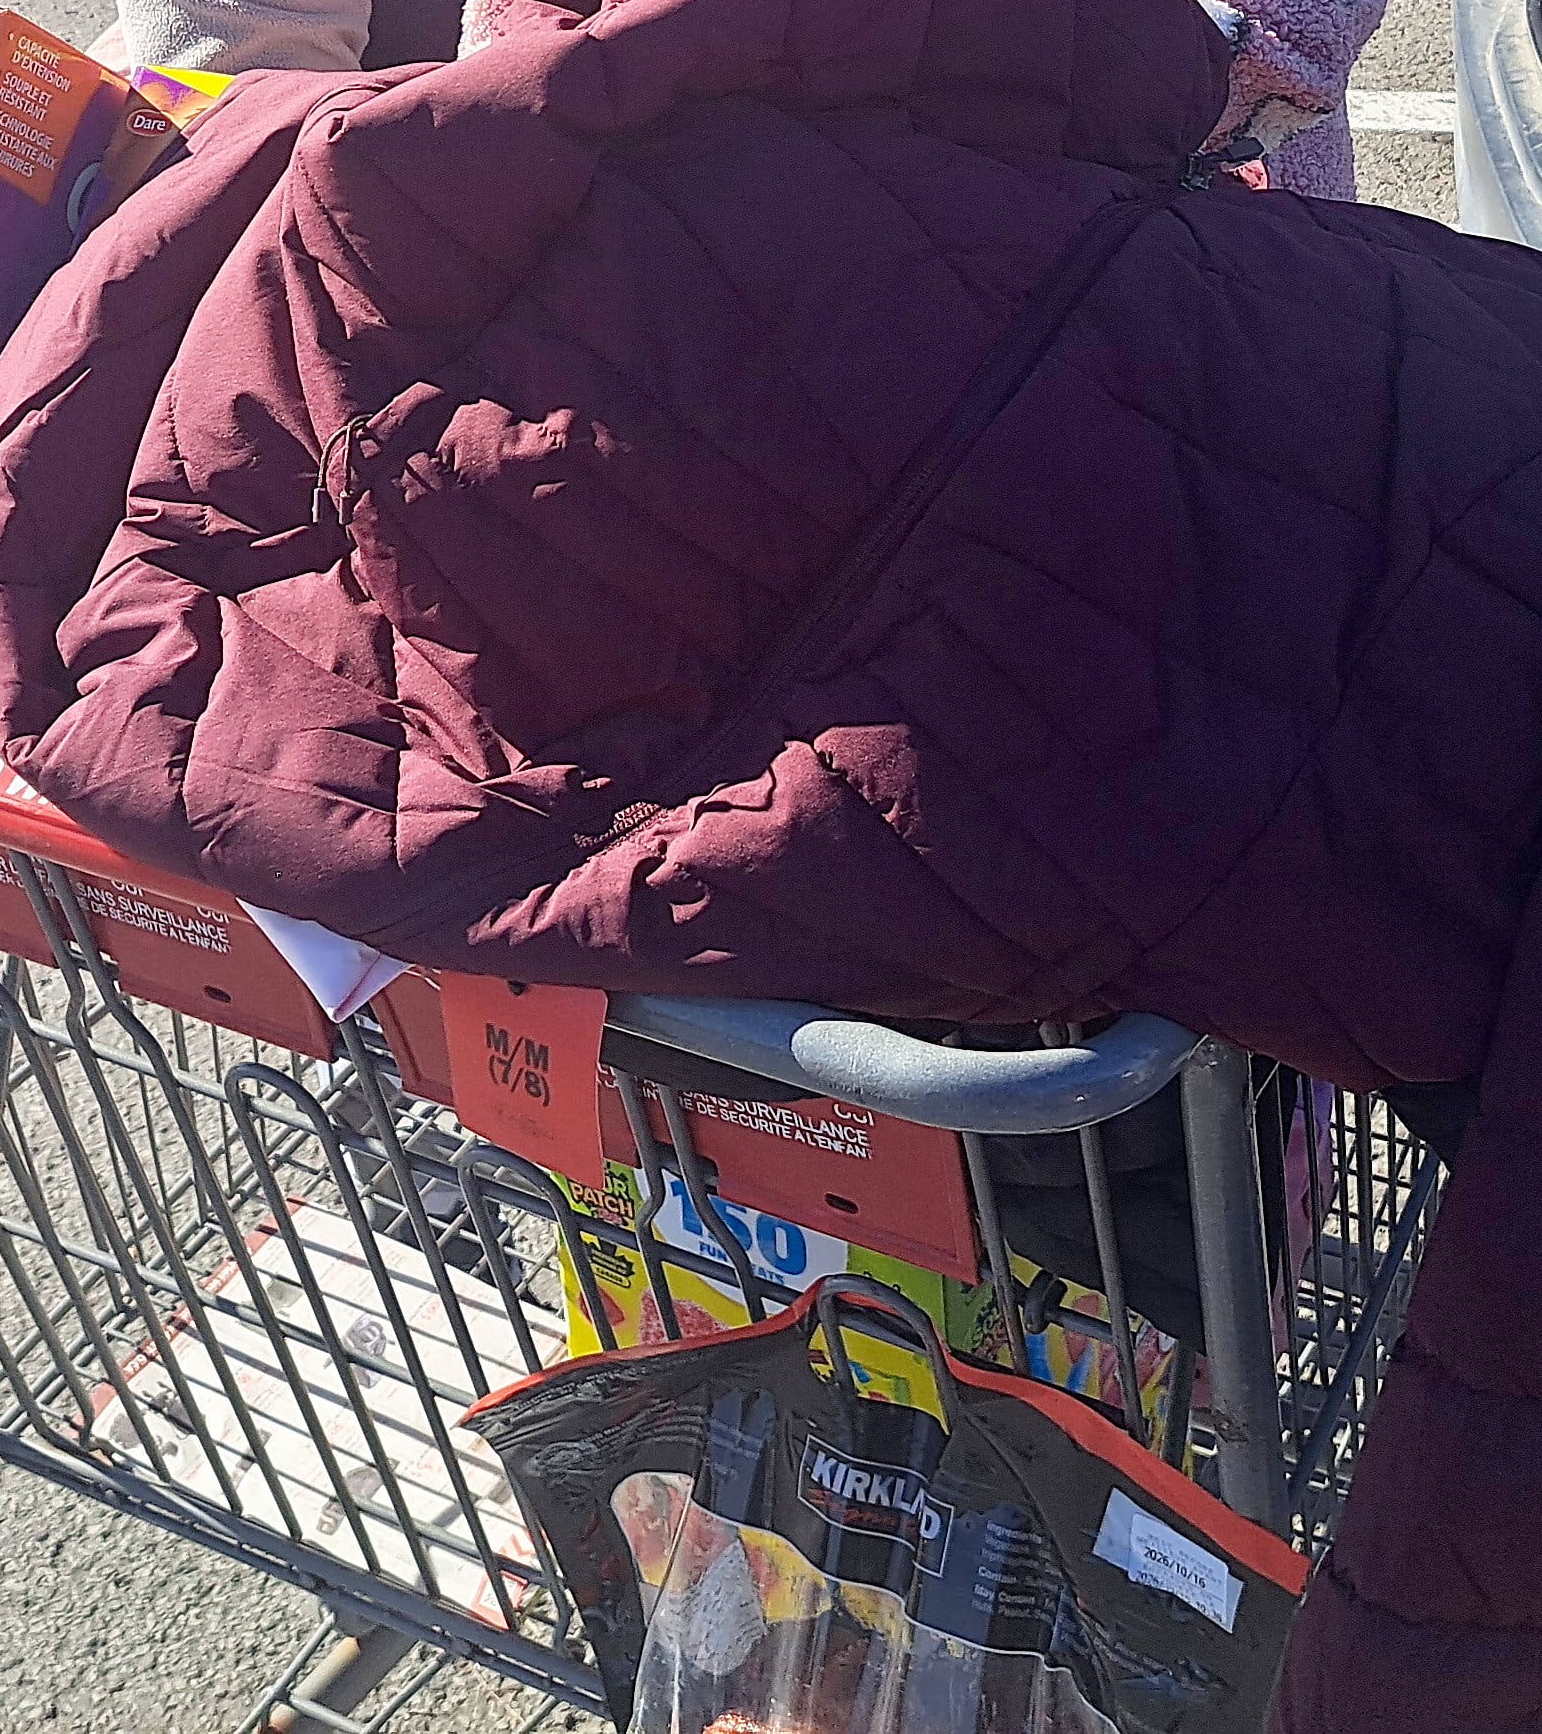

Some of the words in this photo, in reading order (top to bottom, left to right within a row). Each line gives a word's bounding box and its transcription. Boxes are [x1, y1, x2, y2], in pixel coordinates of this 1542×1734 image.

[3, 71, 40, 99] SOUPLE
[38, 90, 53, 107] ET
[11, 51, 71, 92] D'EXTENSION
[133, 115, 166, 132] Dare
[38, 152, 56, 171] AUX
[76, 882, 115, 906] SANS
[119, 896, 230, 944] SURVEILLANCE
[90, 903, 108, 916] DE
[486, 1023, 550, 1073] M/M
[489, 1054, 551, 1107] (7/8)
[696, 1100, 718, 1118] DE
[732, 1099, 871, 1147] SURVEILLANCE
[570, 1181, 635, 1218] PATCH
